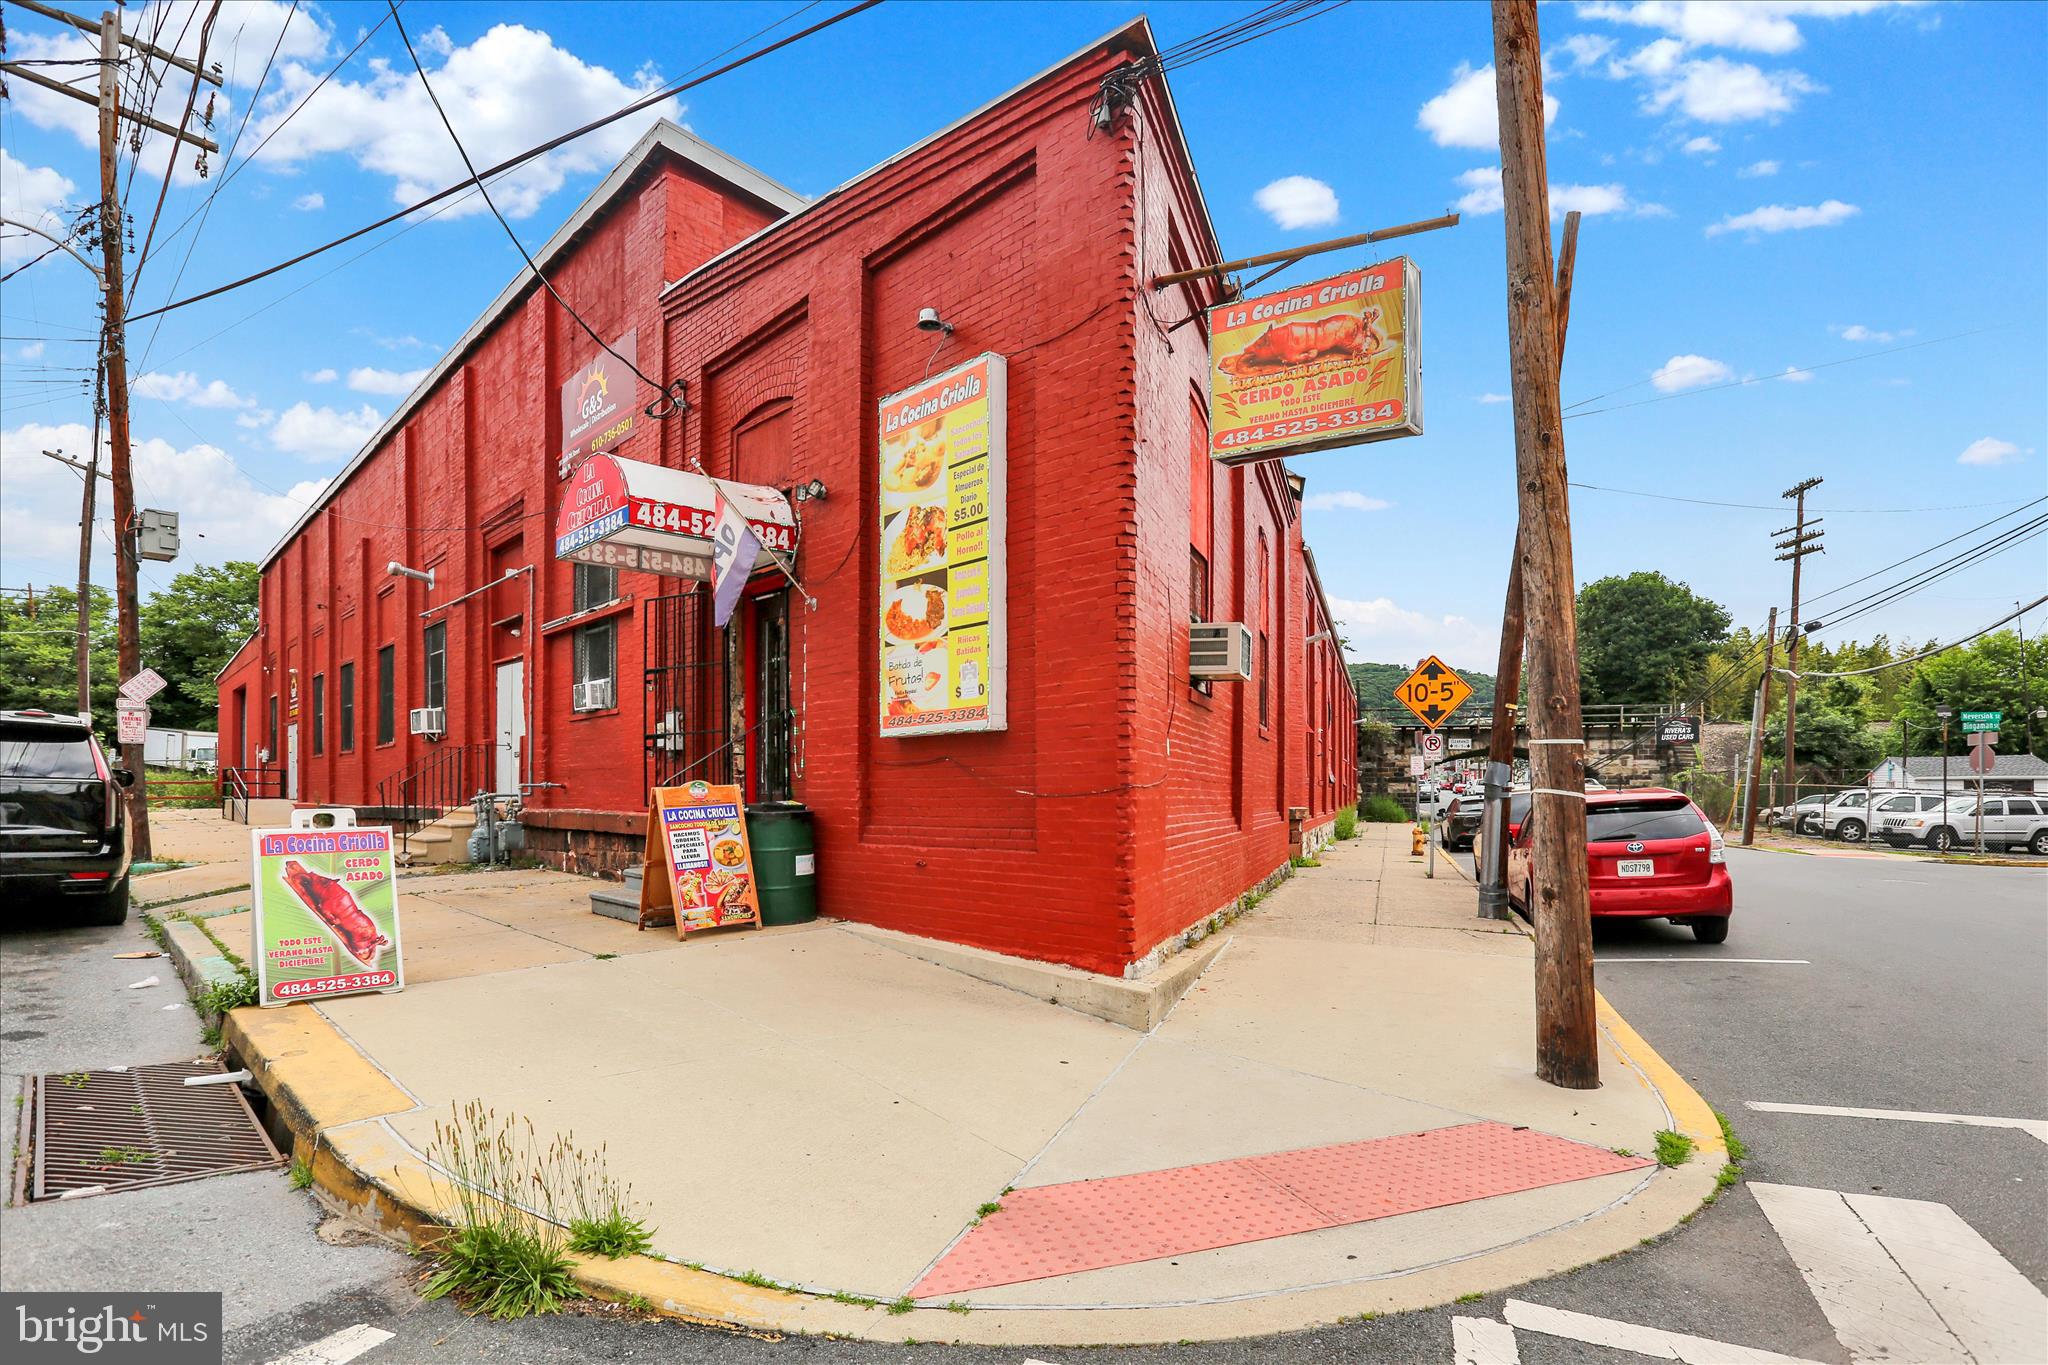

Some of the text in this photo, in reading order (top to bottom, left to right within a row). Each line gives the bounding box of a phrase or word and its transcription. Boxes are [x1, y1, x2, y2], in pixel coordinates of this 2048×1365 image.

[1226, 274, 1385, 328] La Cocina Criolla
[1238, 383, 1295, 406] CERDO
[1303, 368, 1369, 394] ASADO
[582, 389, 603, 419] G&S
[886, 373, 981, 433] La Cocina Criolla
[1280, 393, 1321, 408] TODO ESTE
[1249, 397, 1356, 424] VERANO HASTA DICIEMBRE
[591, 416, 633, 451] 610-736-0501
[1221, 403, 1394, 446] 484-525-3384
[583, 463, 596, 483] LA
[953, 463, 985, 480] Especial de
[955, 477, 983, 493] Almuerzos
[961, 492, 978, 504] Diario
[954, 502, 983, 521] $5.00
[559, 511, 624, 553] 484-525-3384
[956, 527, 984, 543] Pollo al
[956, 541, 983, 557] Horno!!
[888, 707, 986, 727] 484-525-3384
[667, 806, 737, 822] LA COCINA CRIOLLA
[265, 834, 385, 854] La Cocina Criolla
[344, 858, 380, 868] CERDO
[345, 871, 384, 882] ASADO
[279, 937, 322, 947] TODO ESTE
[268, 946, 334, 959] VERANO HASTA
[279, 957, 325, 968] DICIEMBRE
[279, 973, 391, 997] 484-525-3384
